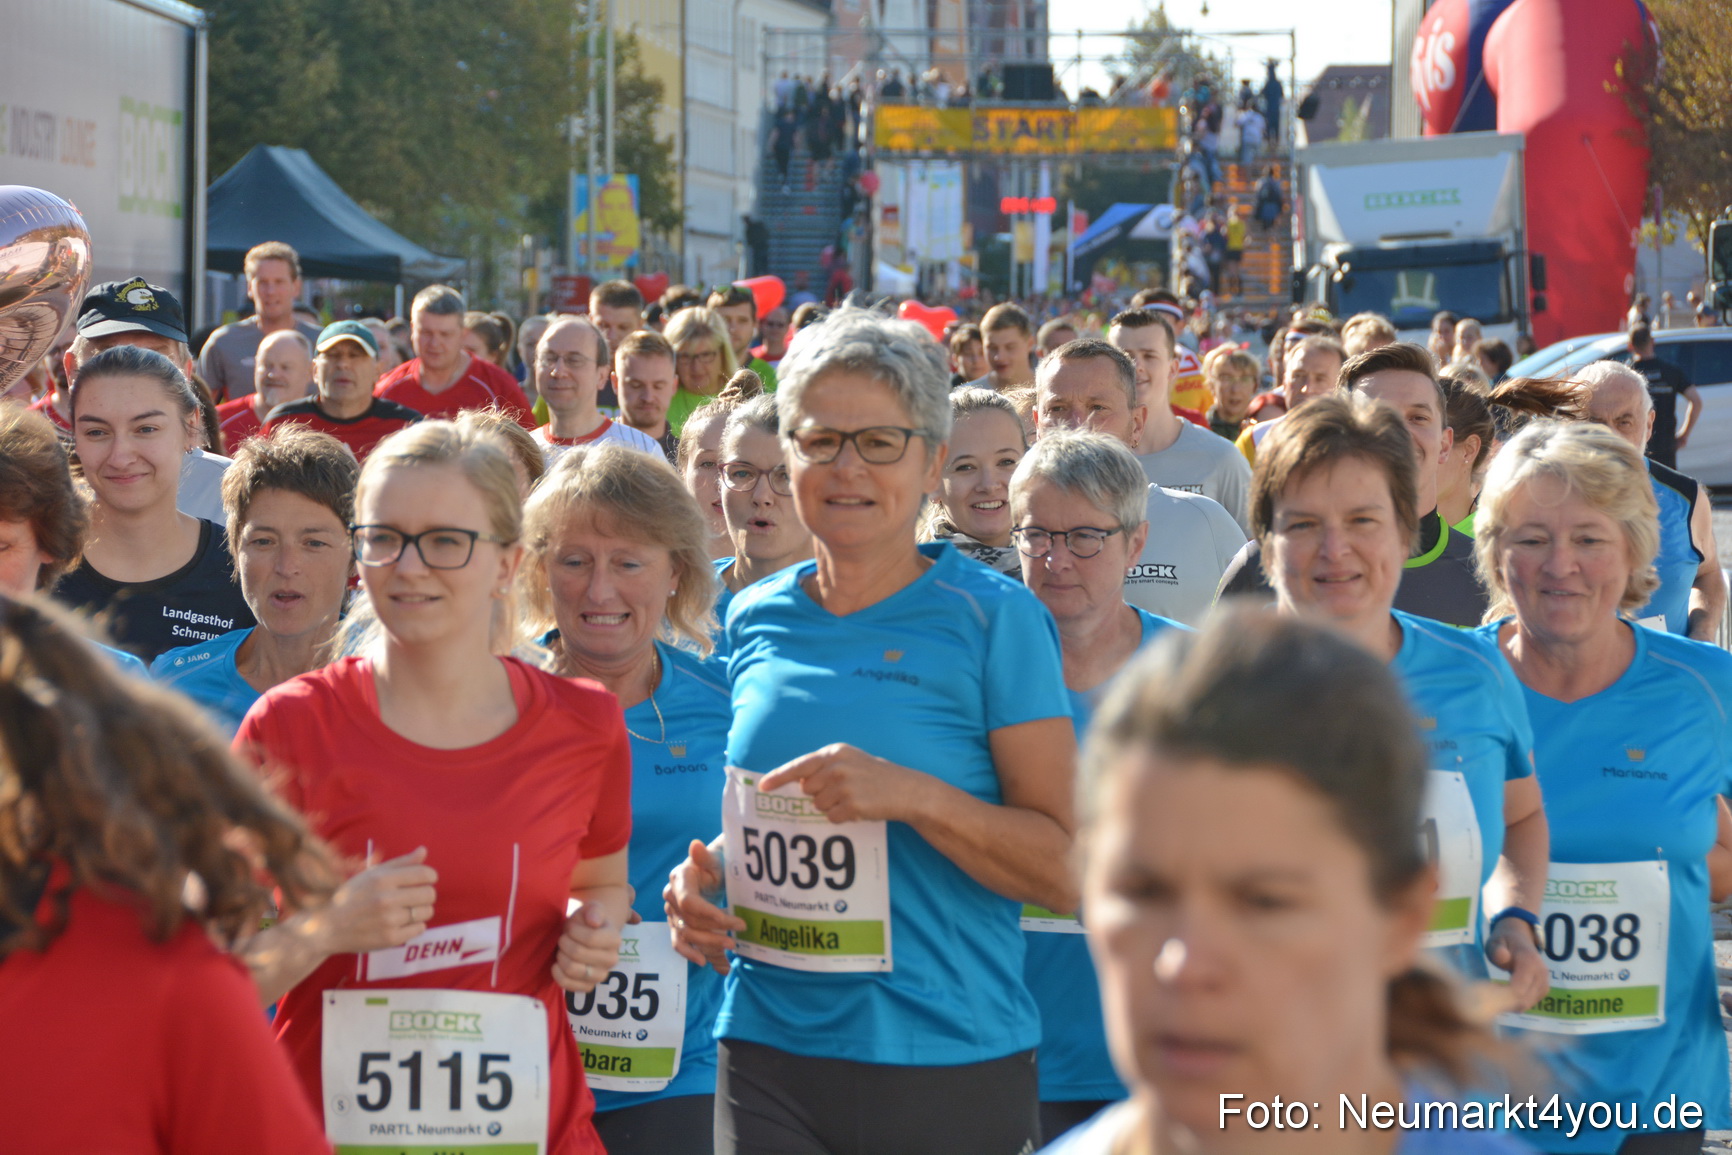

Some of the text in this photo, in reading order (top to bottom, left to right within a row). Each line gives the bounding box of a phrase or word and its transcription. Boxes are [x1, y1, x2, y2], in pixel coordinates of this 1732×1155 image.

[973, 113, 1078, 141] START
[1127, 564, 1178, 580] OCK
[162, 605, 234, 630] Landgasthof
[187, 652, 211, 663] JAKO
[654, 763, 708, 775] Barbara
[1602, 767, 1669, 781] Marianne
[743, 826, 856, 890] 5039
[754, 891, 830, 912] PARTL Neumarkt
[760, 918, 840, 951] Angelika
[1544, 912, 1642, 963] 038
[404, 936, 464, 964] DEHN
[1561, 971, 1615, 982] Neumarkt
[565, 971, 660, 1022] 035
[1532, 994, 1624, 1015] arianne
[389, 1010, 482, 1034] BOCK
[579, 1025, 632, 1040] Neumarkt
[356, 1050, 514, 1113] 5115
[369, 1122, 481, 1137] PARTL Neumarkt
